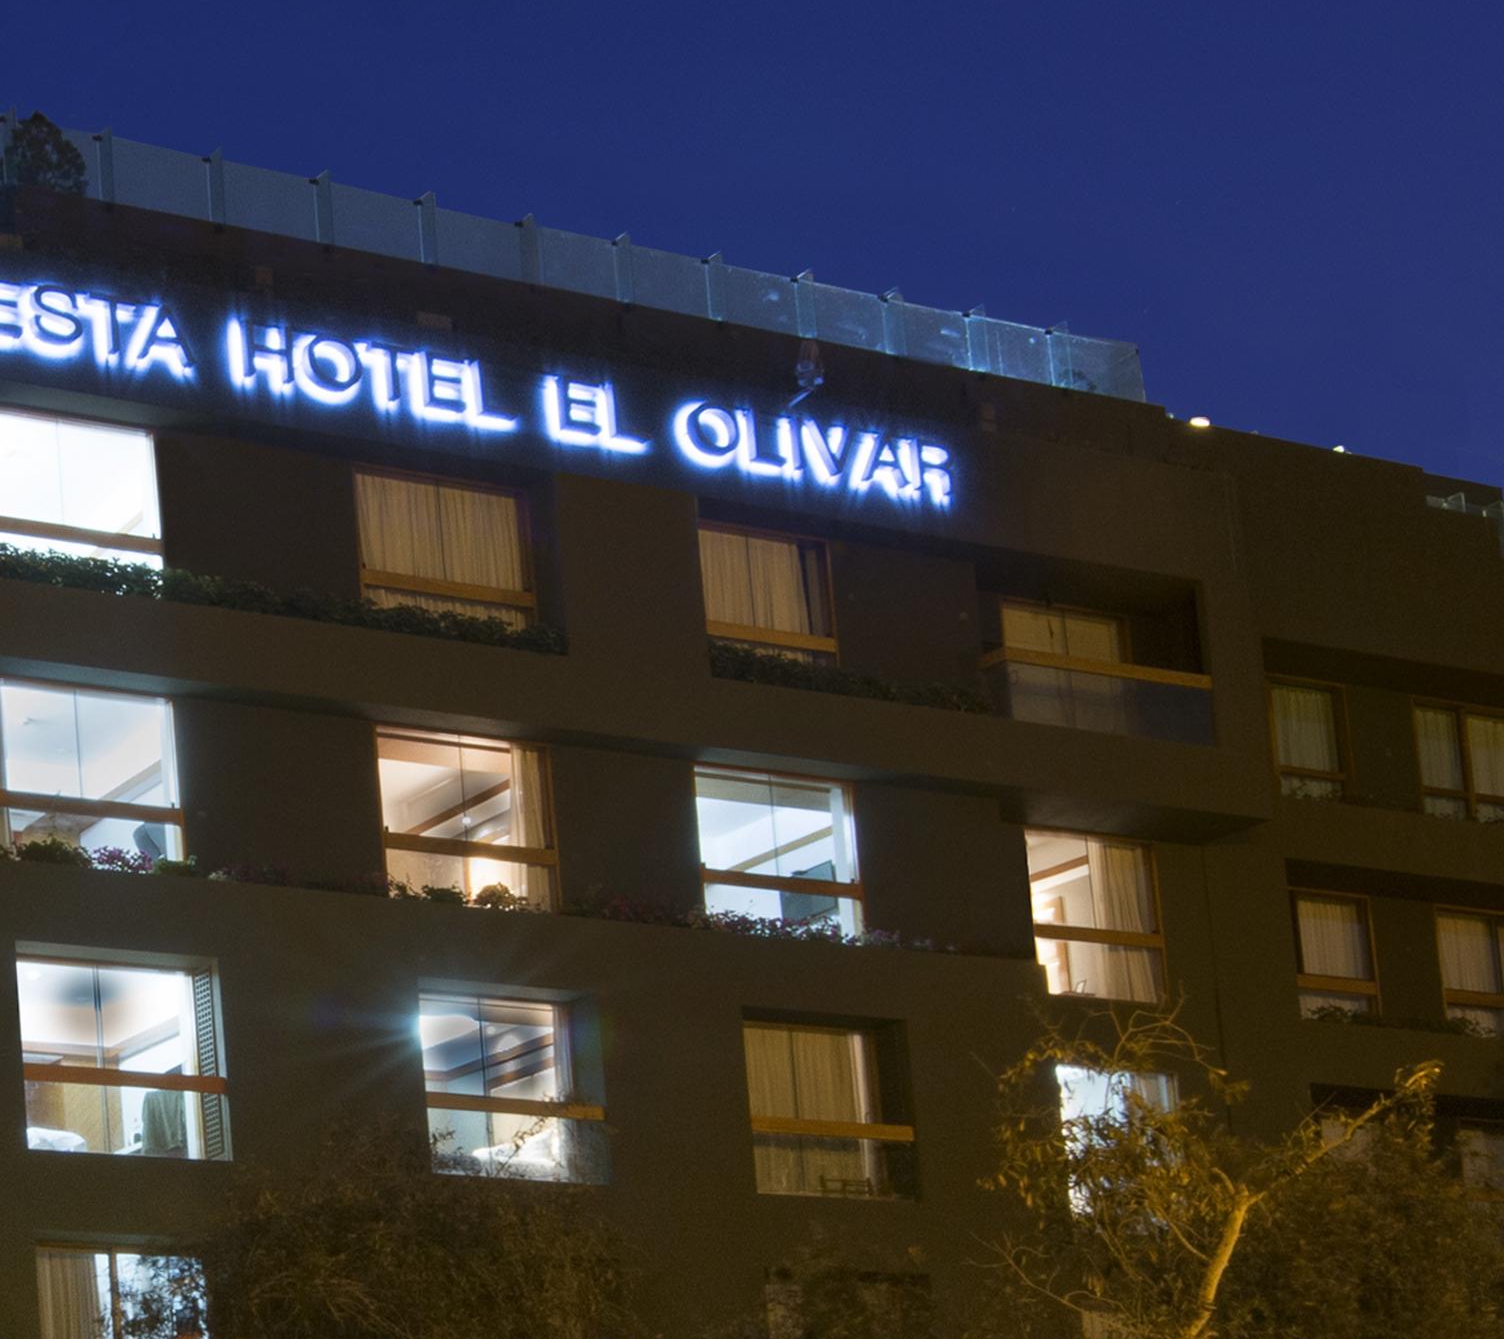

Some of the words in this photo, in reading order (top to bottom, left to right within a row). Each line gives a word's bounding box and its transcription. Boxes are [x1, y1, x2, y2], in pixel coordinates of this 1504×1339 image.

[227, 317, 520, 432] HOTEL
[544, 373, 652, 454] EL
[673, 398, 953, 506] OLIVAR
